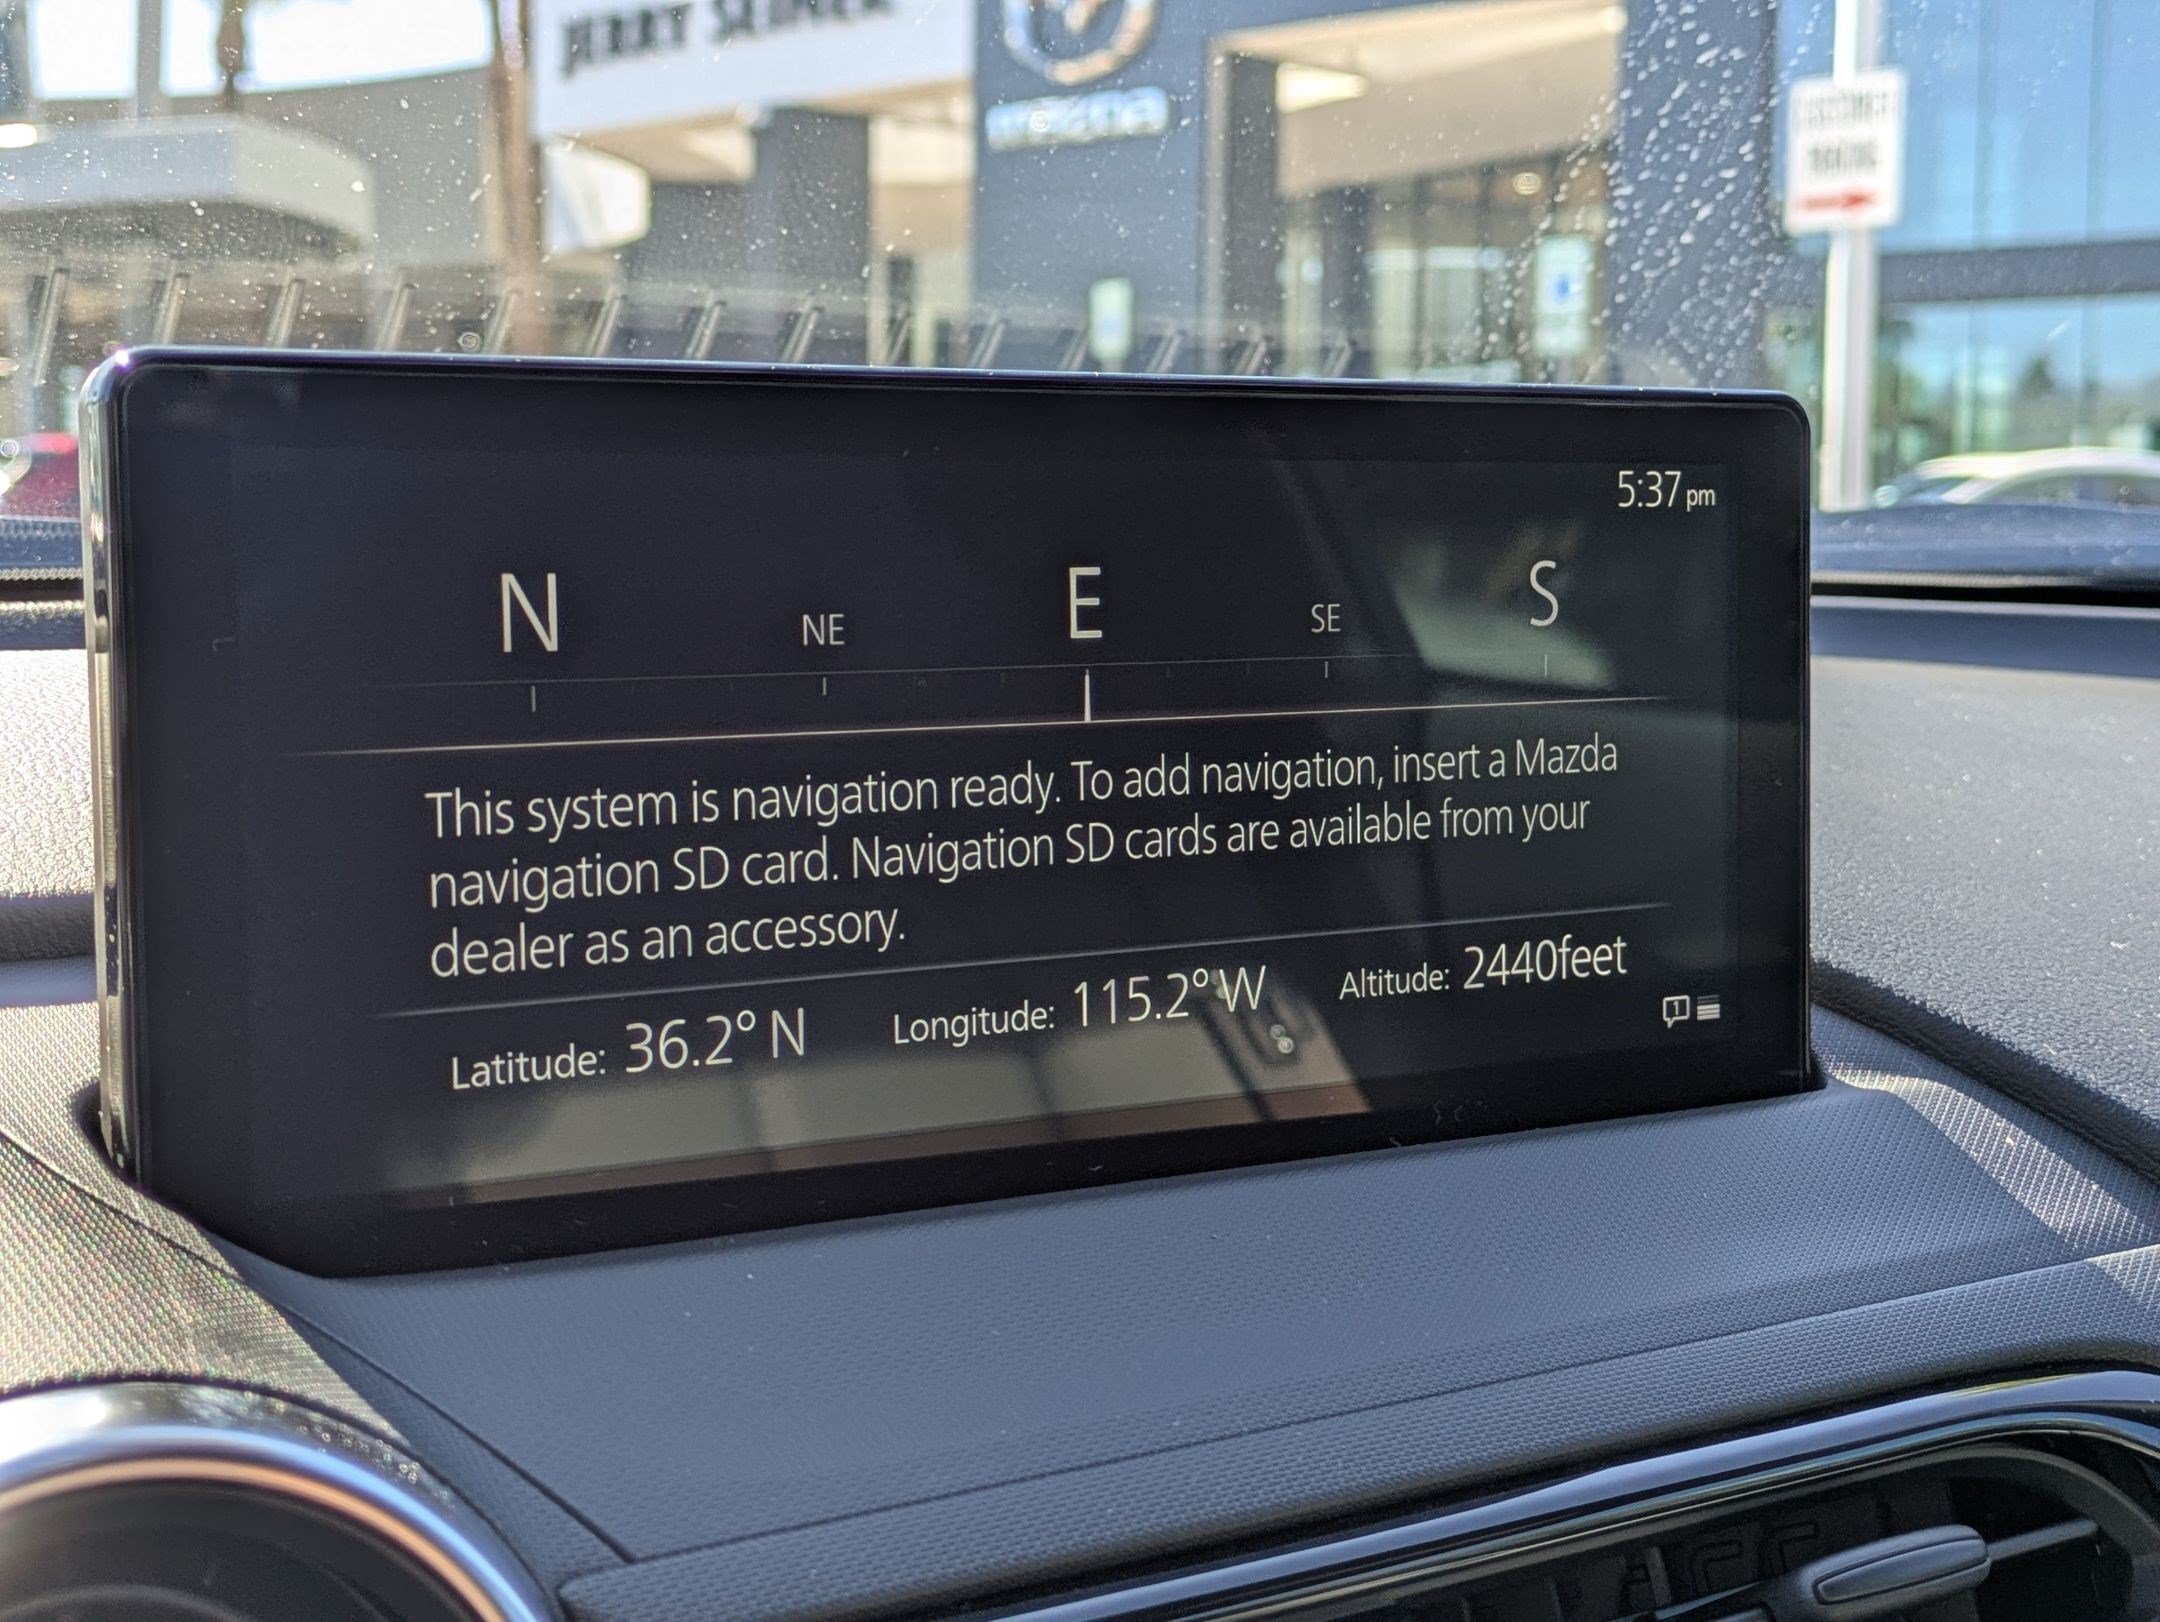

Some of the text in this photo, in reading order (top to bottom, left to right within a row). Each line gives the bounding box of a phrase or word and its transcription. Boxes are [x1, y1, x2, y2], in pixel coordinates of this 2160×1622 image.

[501, 559, 1559, 653] N NE E SE S
[424, 731, 1617, 844] This system is navigation ready. To add navigation, insert a Mazda
[430, 796, 1591, 914] navigation SD card. Navigation SD cards are available from your
[431, 908, 905, 978] dealer as an accessory.
[1339, 961, 1450, 1000] Altitude:
[894, 999, 1055, 1048] Longitude:
[452, 1042, 606, 1090] Latitude:
